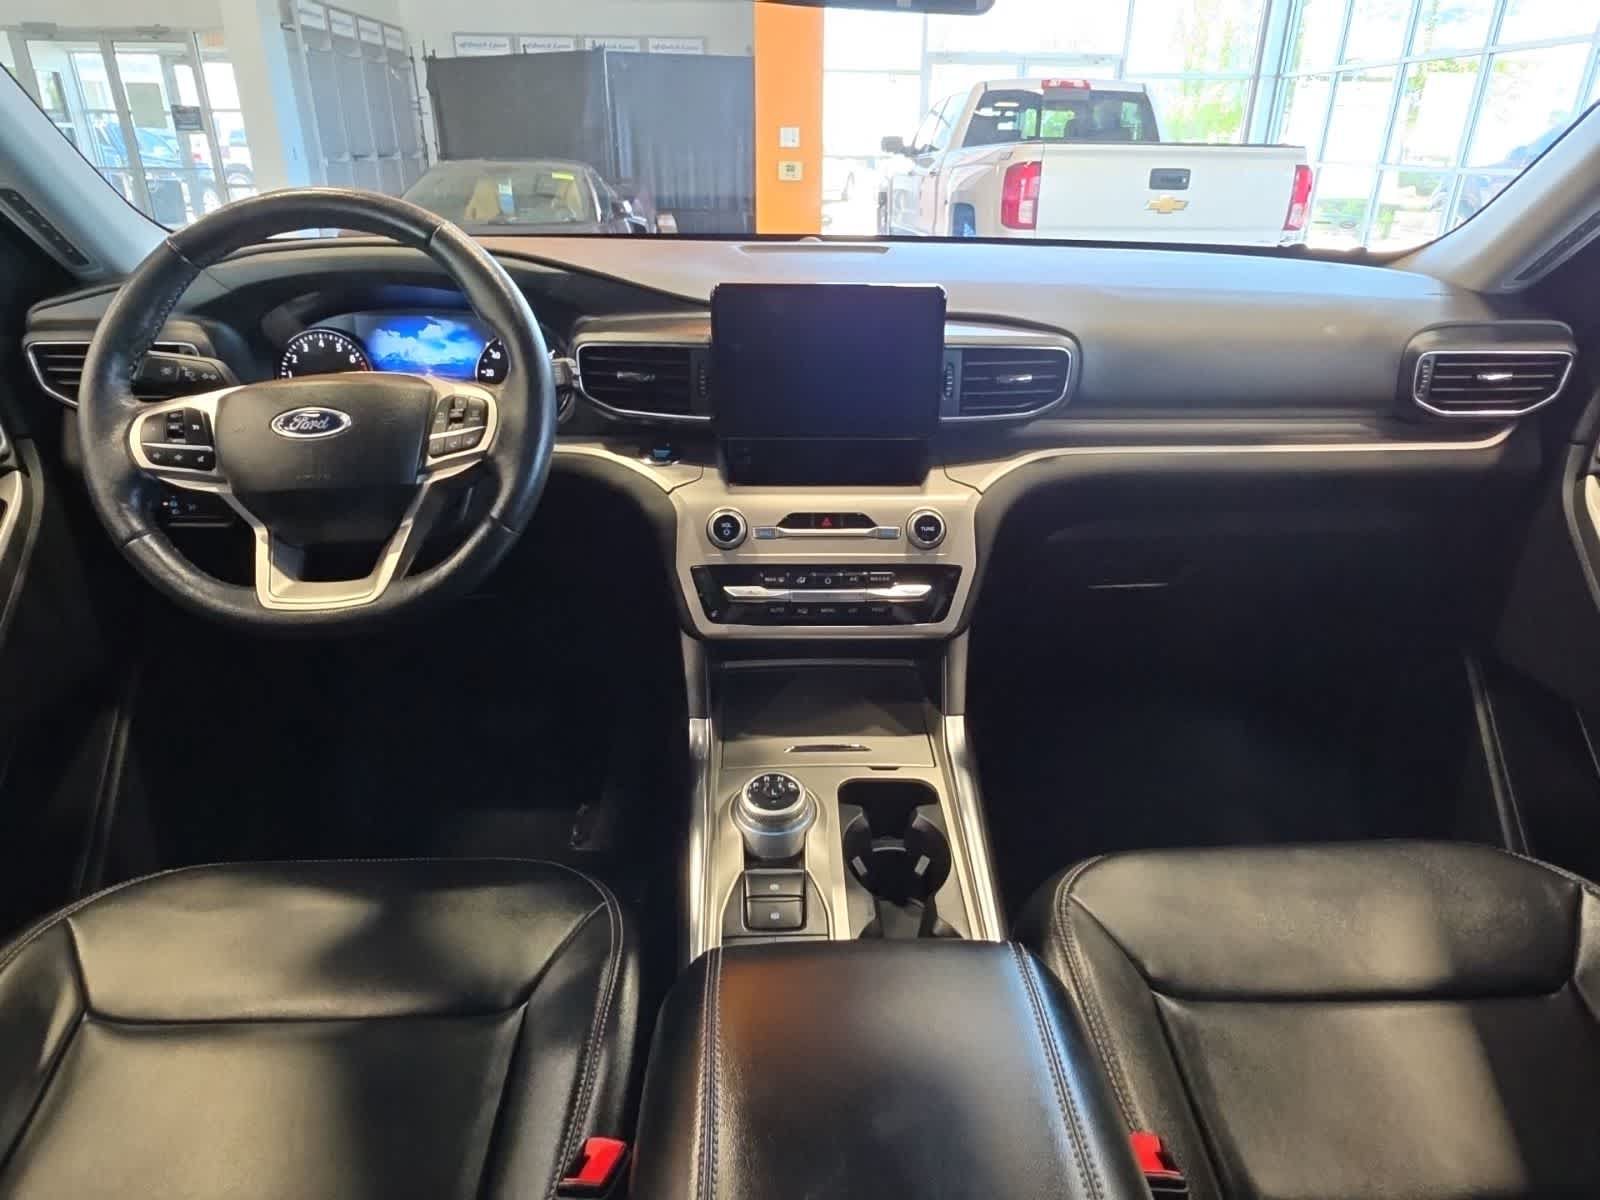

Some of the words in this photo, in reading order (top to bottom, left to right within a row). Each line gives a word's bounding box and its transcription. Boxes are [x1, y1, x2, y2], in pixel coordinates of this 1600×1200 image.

[303, 343, 309, 352] 3
[318, 340, 324, 348] 4
[336, 343, 342, 352] 5
[292, 355, 298, 363] 2
[349, 354, 356, 364] 6
[486, 369, 495, 377] 20
[284, 412, 330, 430] Ford
